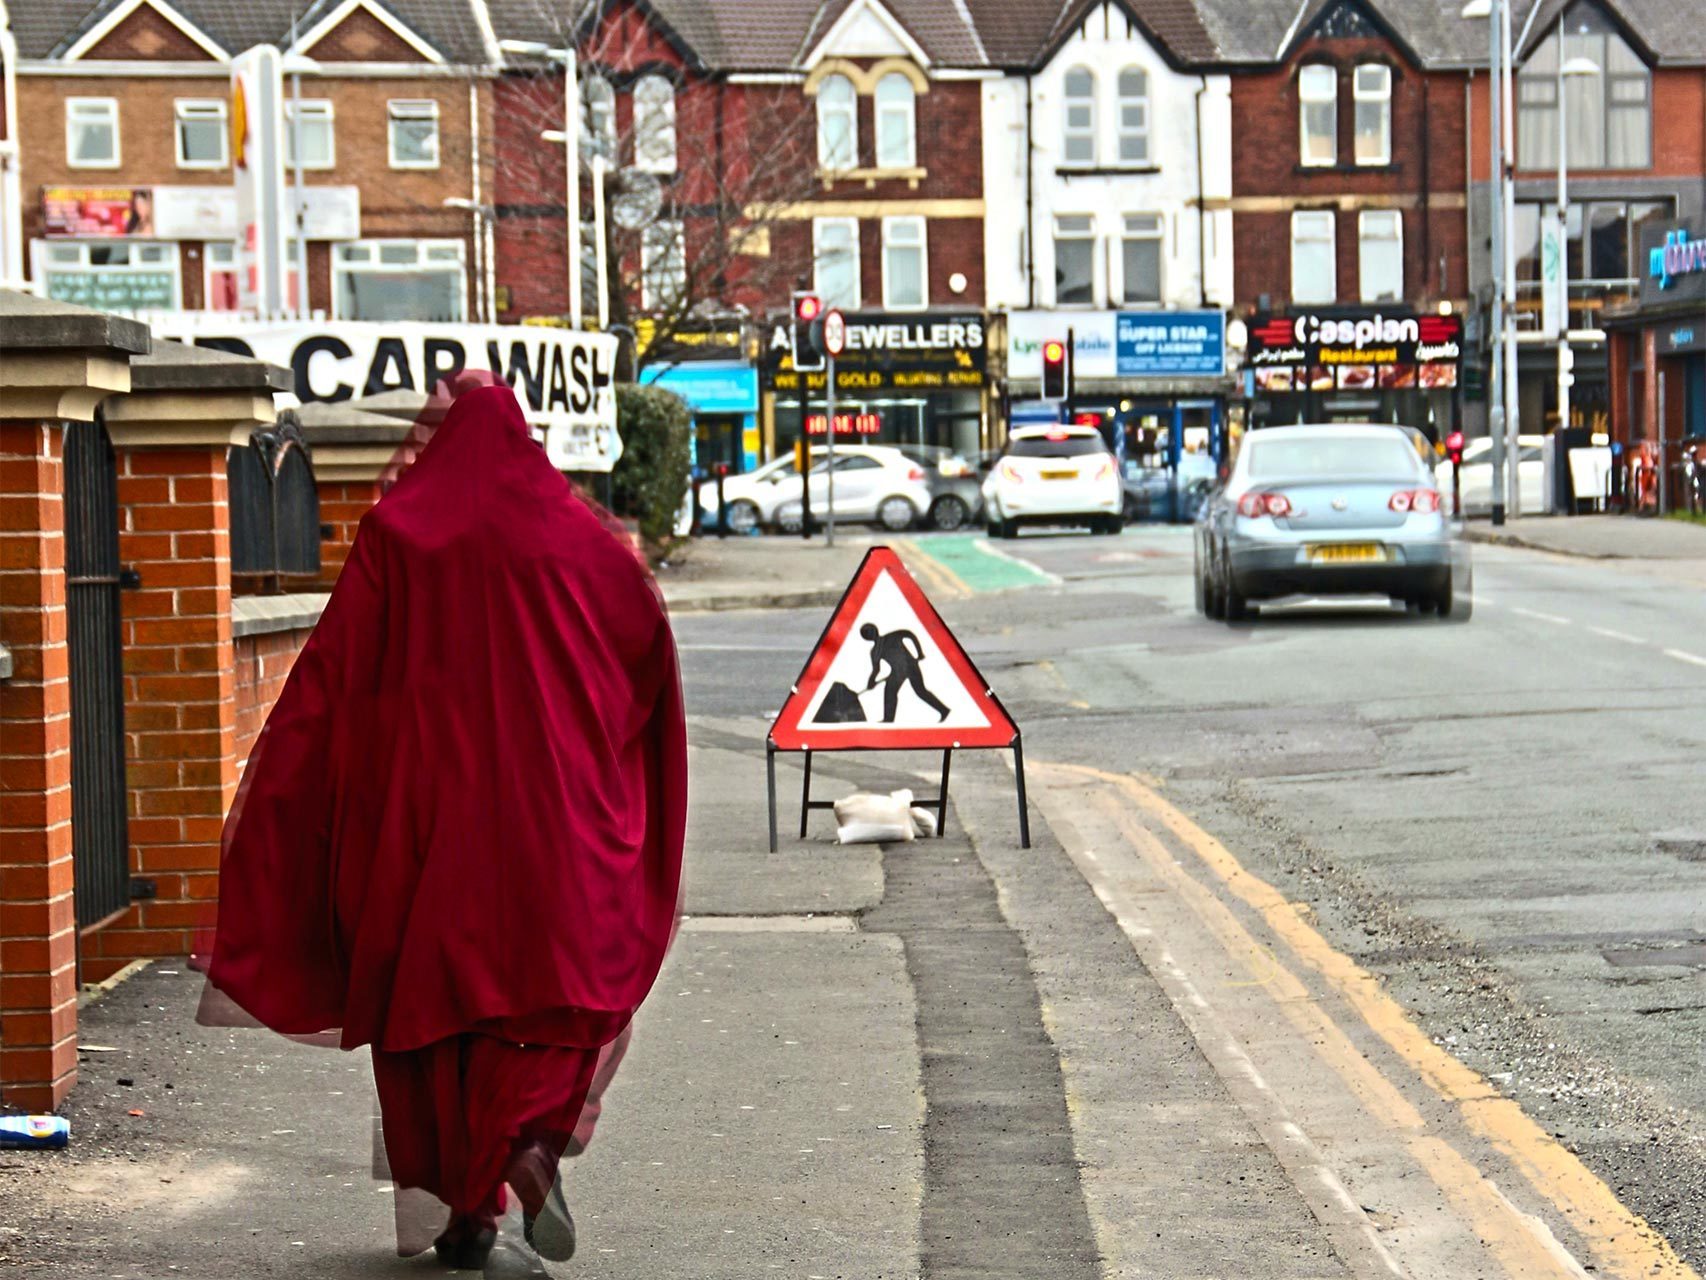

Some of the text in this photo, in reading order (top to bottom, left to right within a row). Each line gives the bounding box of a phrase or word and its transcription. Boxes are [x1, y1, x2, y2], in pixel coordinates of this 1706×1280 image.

[845, 323, 983, 349] EWELLERS
[291, 336, 466, 403] CAR
[837, 372, 881, 387] GOLD
